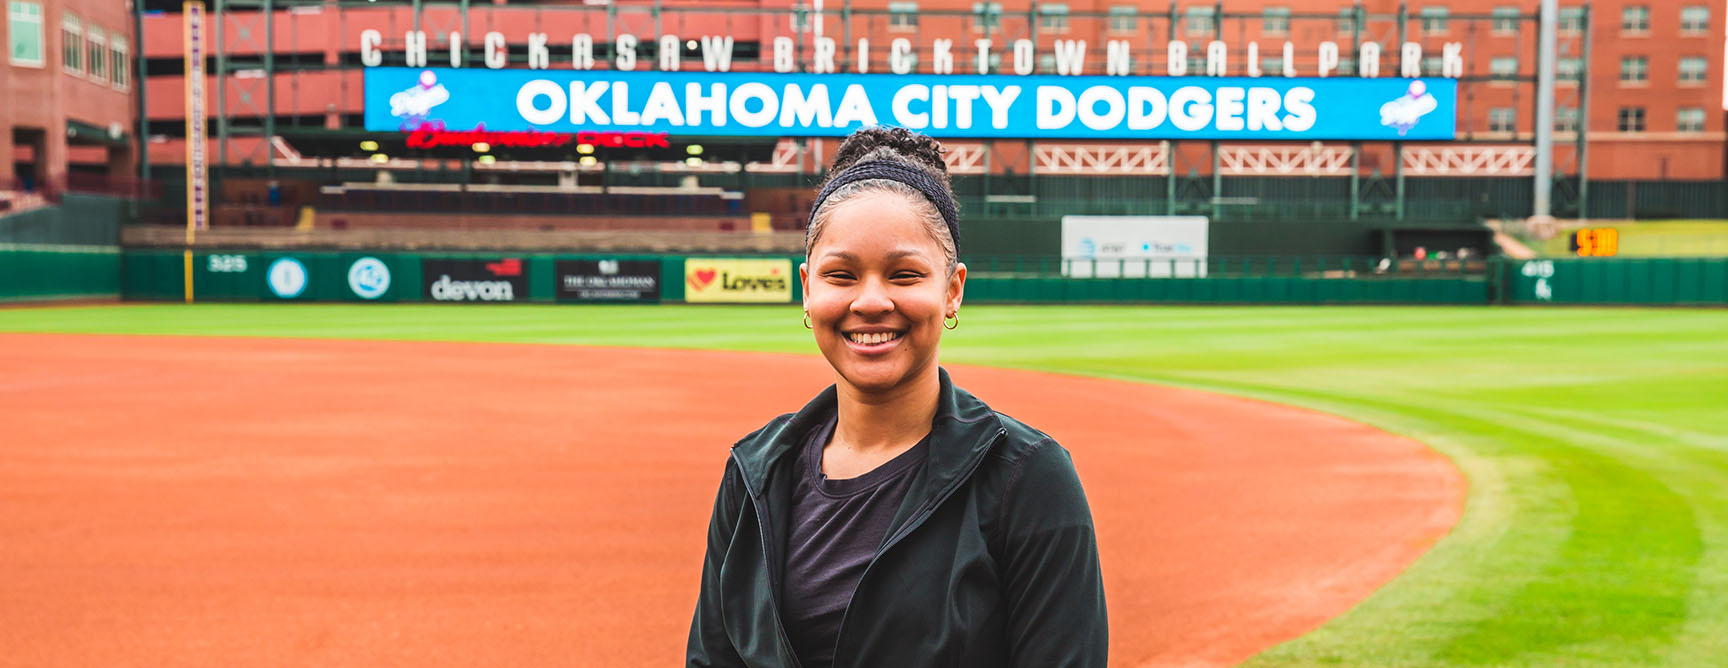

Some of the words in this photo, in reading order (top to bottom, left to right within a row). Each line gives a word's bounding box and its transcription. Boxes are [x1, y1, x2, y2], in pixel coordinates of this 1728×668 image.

[361, 29, 734, 72] CHICKASAW
[773, 36, 1130, 76] BRICKTOWN
[1167, 40, 1463, 78] BALLPARK
[516, 79, 878, 128] OKLAHOMA
[892, 84, 1022, 129] CITY
[1036, 85, 1317, 131] DODGERS
[576, 131, 669, 148] DECK
[207, 254, 248, 273] 325
[431, 274, 514, 300] devon
